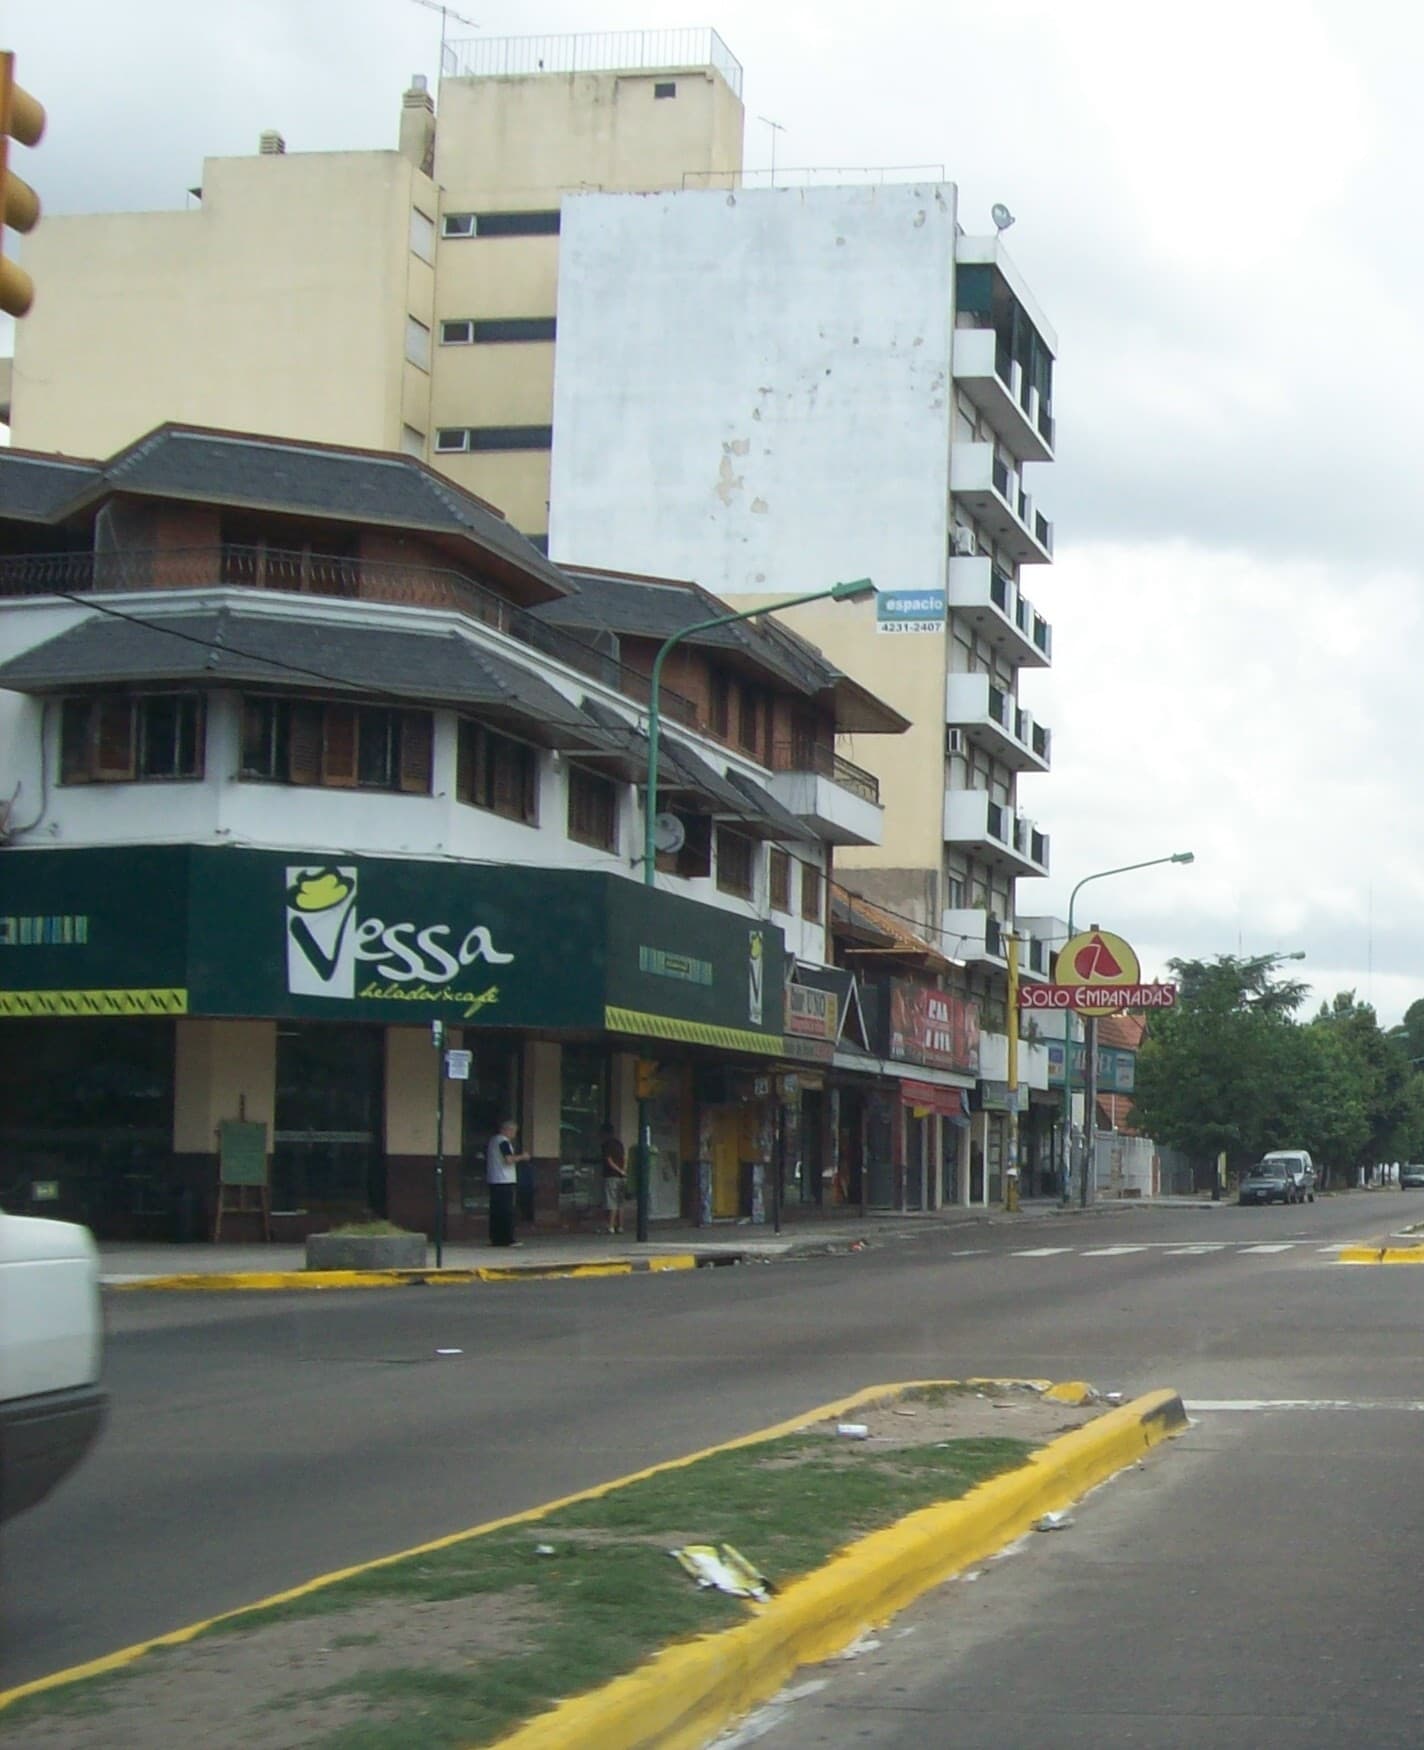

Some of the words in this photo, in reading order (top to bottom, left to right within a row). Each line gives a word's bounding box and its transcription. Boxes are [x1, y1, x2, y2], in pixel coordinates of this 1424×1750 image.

[885, 596, 943, 613] espacio
[881, 623, 941, 632] 4231-2407
[289, 904, 514, 983] Vessa
[1021, 986, 1070, 1007] SOLO
[1075, 986, 1174, 1007] EMPANADAS
